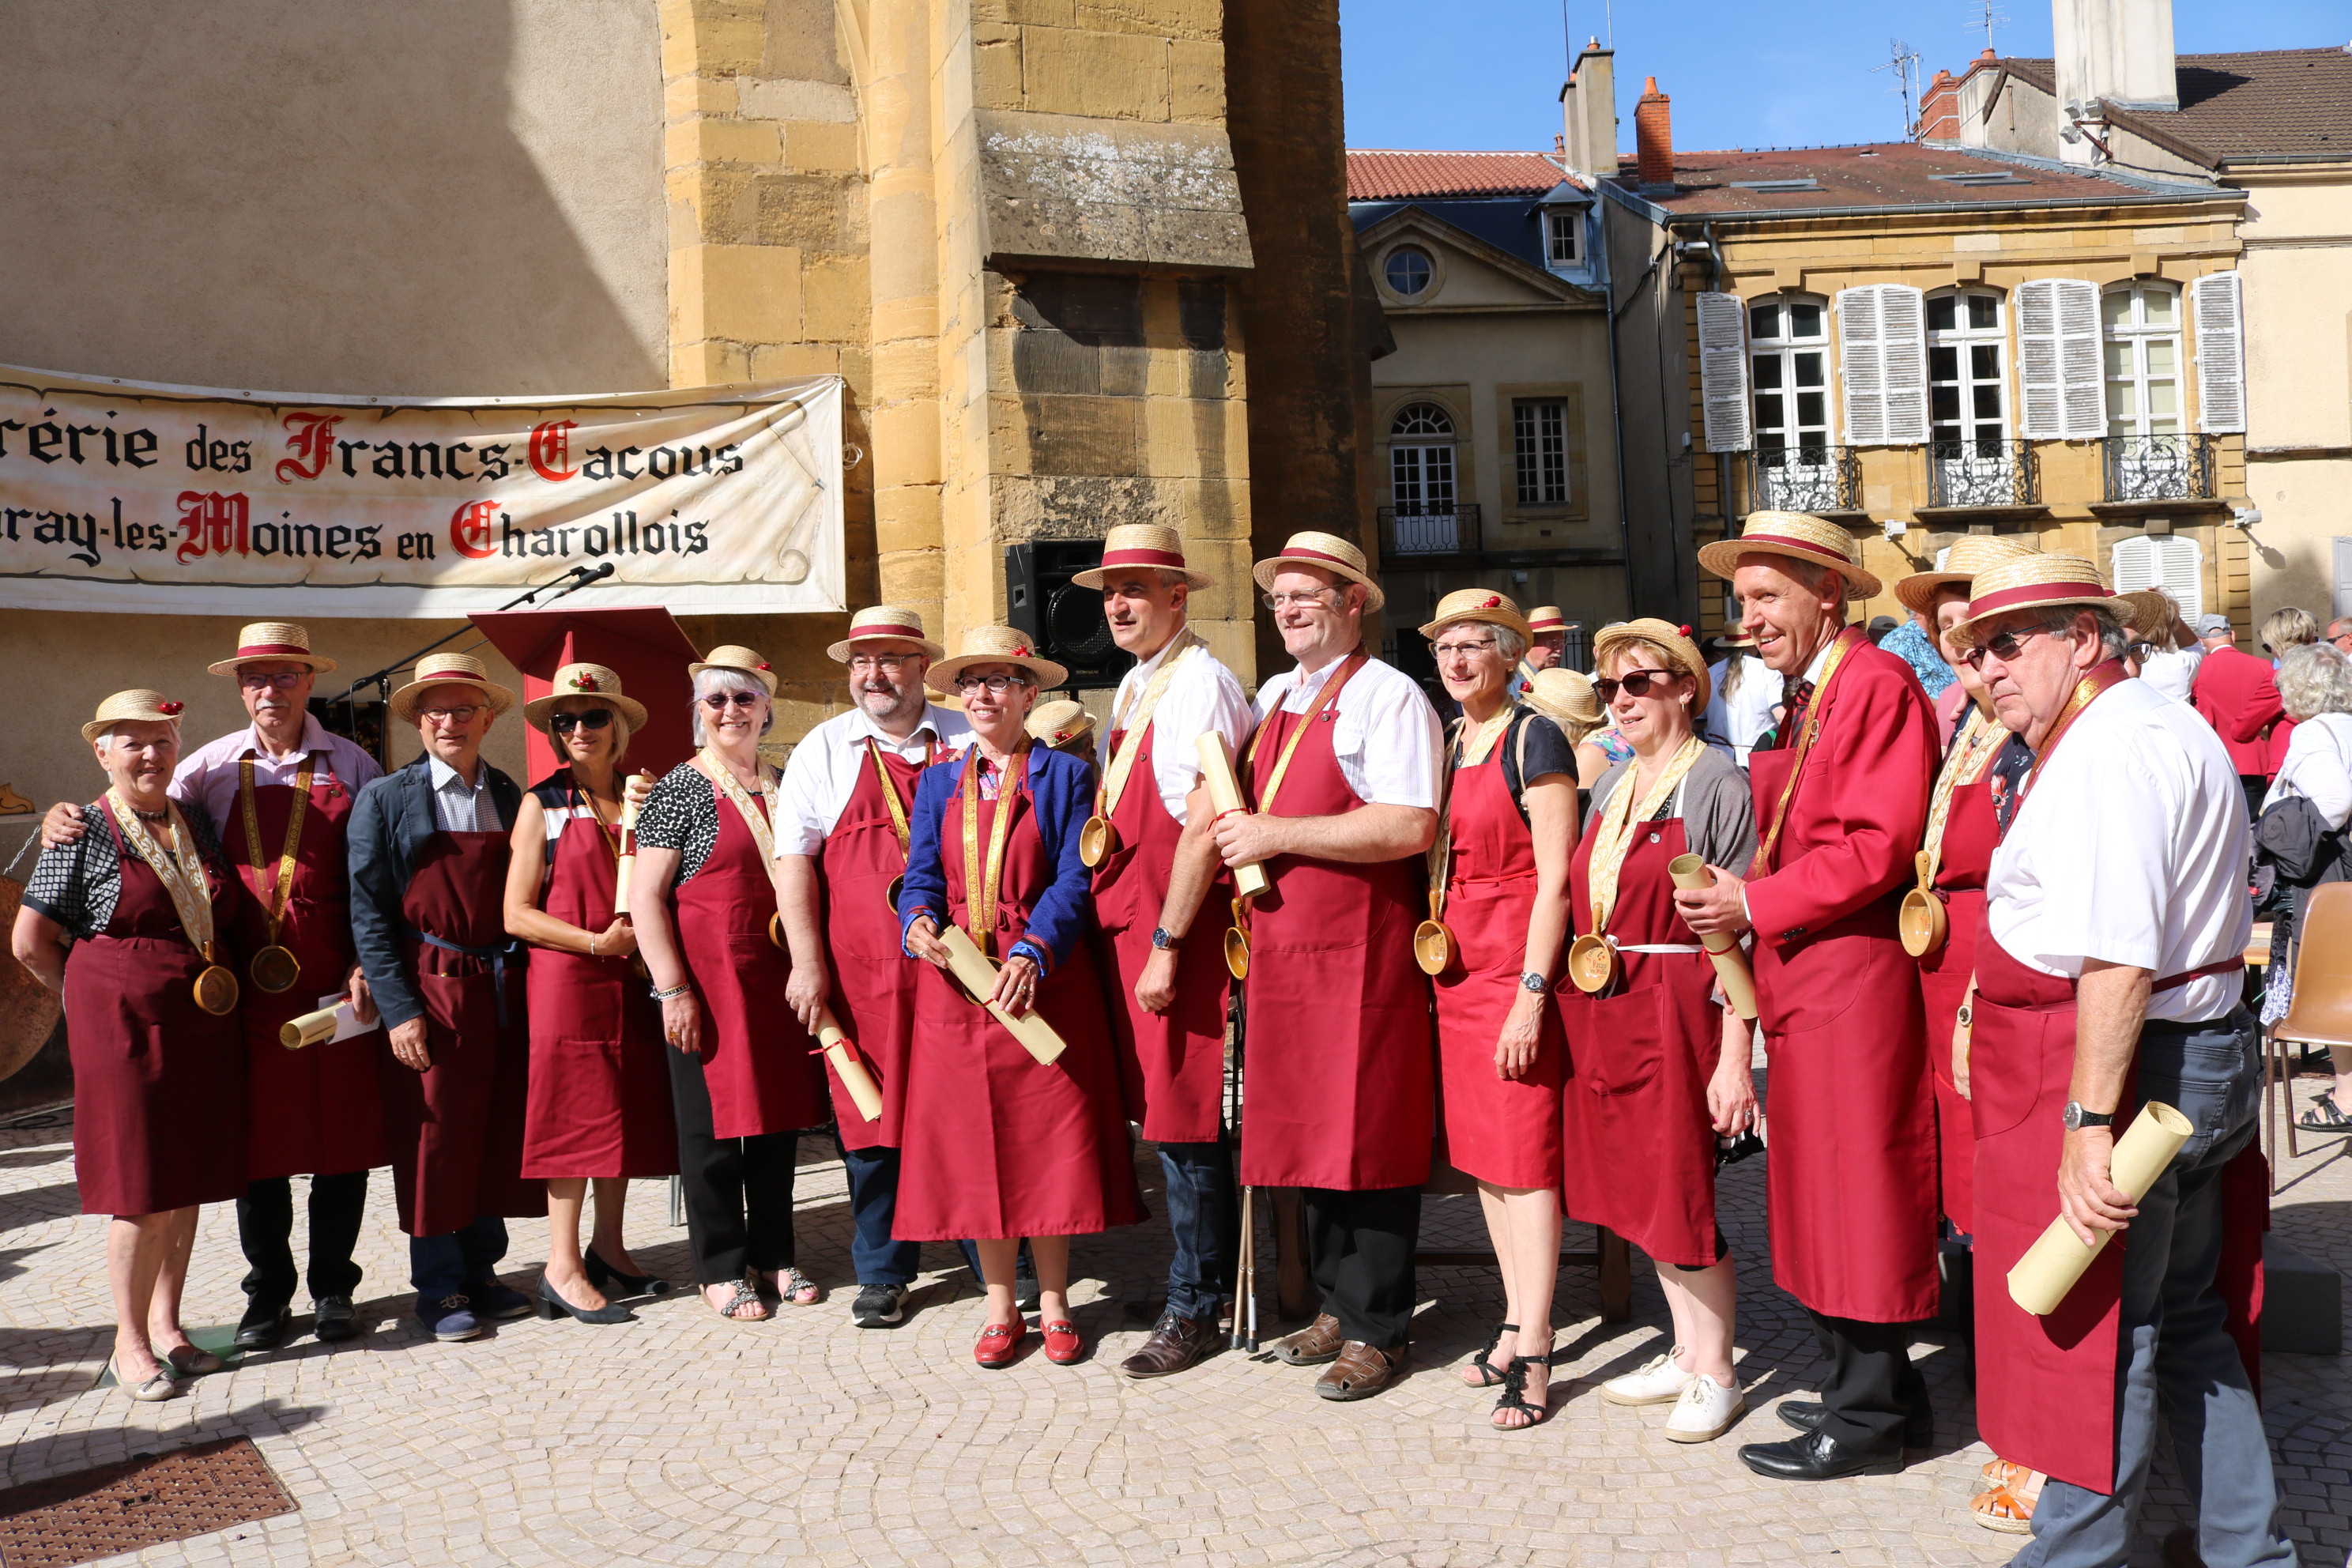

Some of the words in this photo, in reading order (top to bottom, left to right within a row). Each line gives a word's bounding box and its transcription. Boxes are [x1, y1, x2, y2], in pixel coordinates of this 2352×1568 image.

[186, 424, 252, 473] des
[275, 412, 744, 485] Francs-Cacous
[0, 490, 383, 567] ray-les-Moines
[397, 532, 436, 561] en
[450, 499, 710, 560] Charollois
